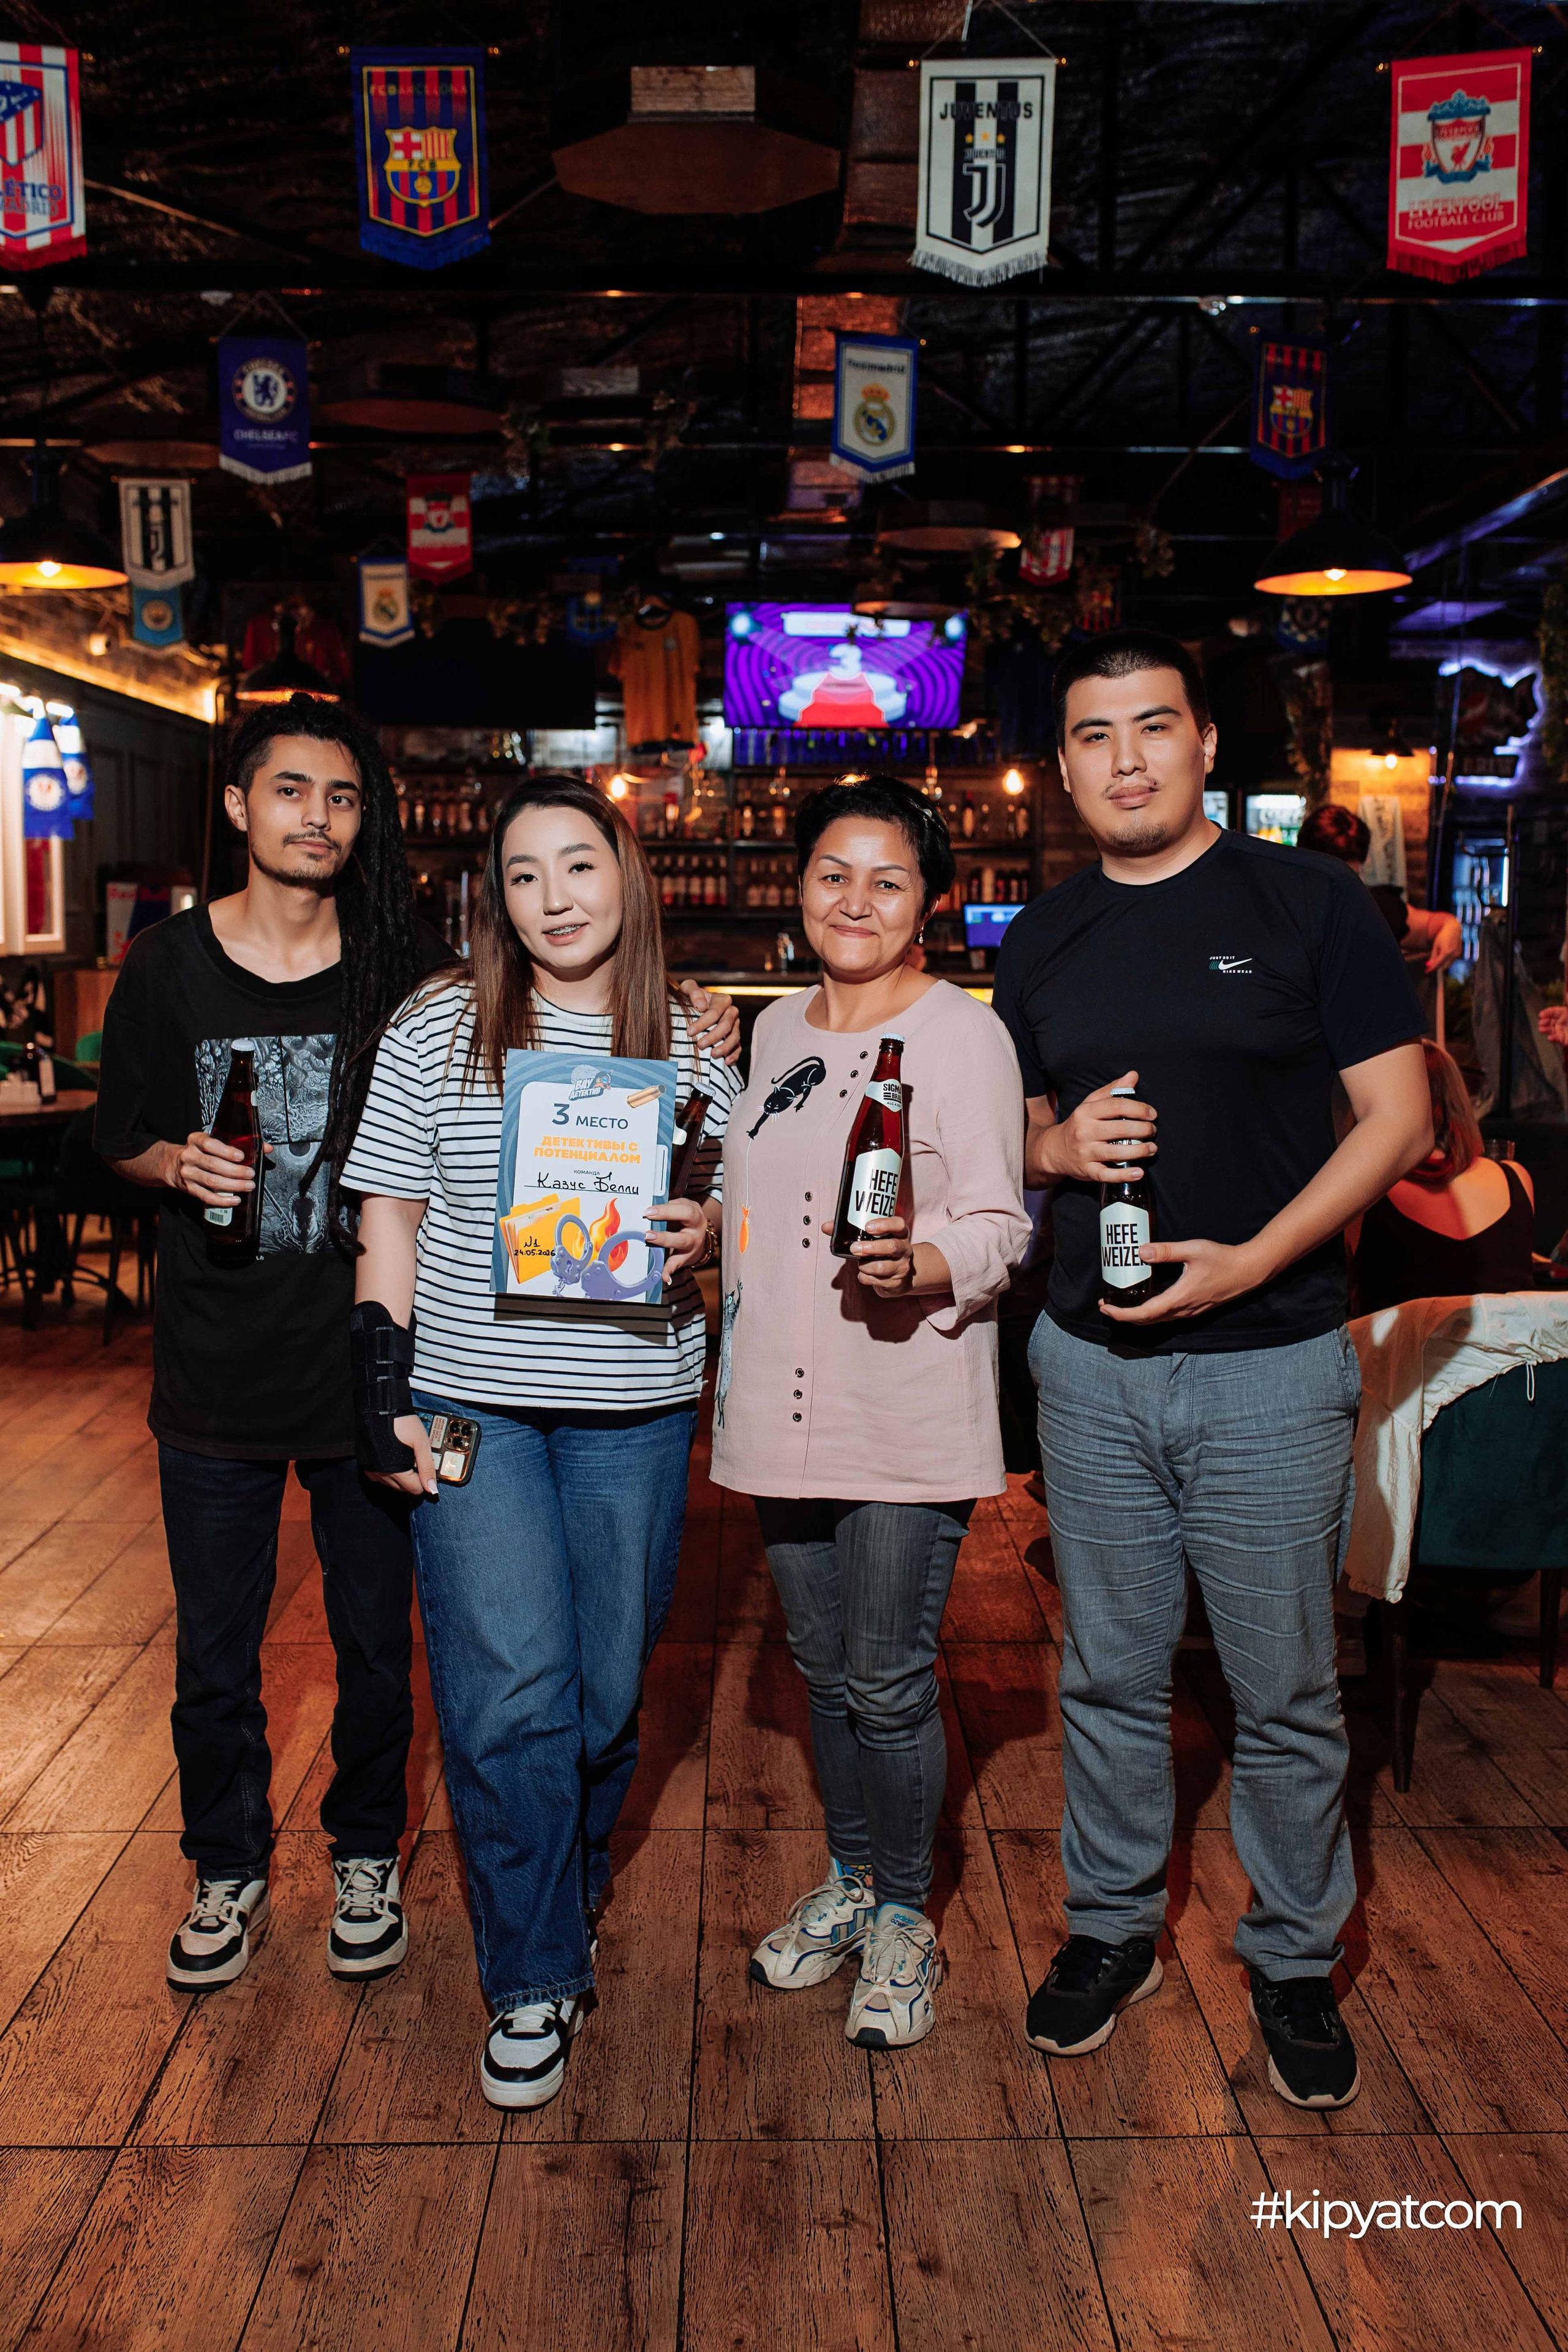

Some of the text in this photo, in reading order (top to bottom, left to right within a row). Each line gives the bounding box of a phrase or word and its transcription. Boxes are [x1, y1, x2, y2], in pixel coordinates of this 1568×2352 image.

[940, 100, 1033, 120] JUVENTUS
[0, 178, 62, 200] ÉTICO
[1409, 192, 1504, 219] LIVERPOOL
[1408, 214, 1469, 230] FOOTBALL
[552, 1103, 628, 1129] 3 МЕСТО
[541, 1136, 638, 1152] ДЕТЕКТИВЫ С
[533, 1147, 641, 1164] ПОТЕНЦИАЛОМ
[537, 1171, 639, 1195] Казус Белли
[870, 1169, 899, 1196] HEFE
[856, 1190, 896, 1218] WEIZE
[1106, 1224, 1138, 1245] HEFE
[894, 1913, 916, 1926] adidas
